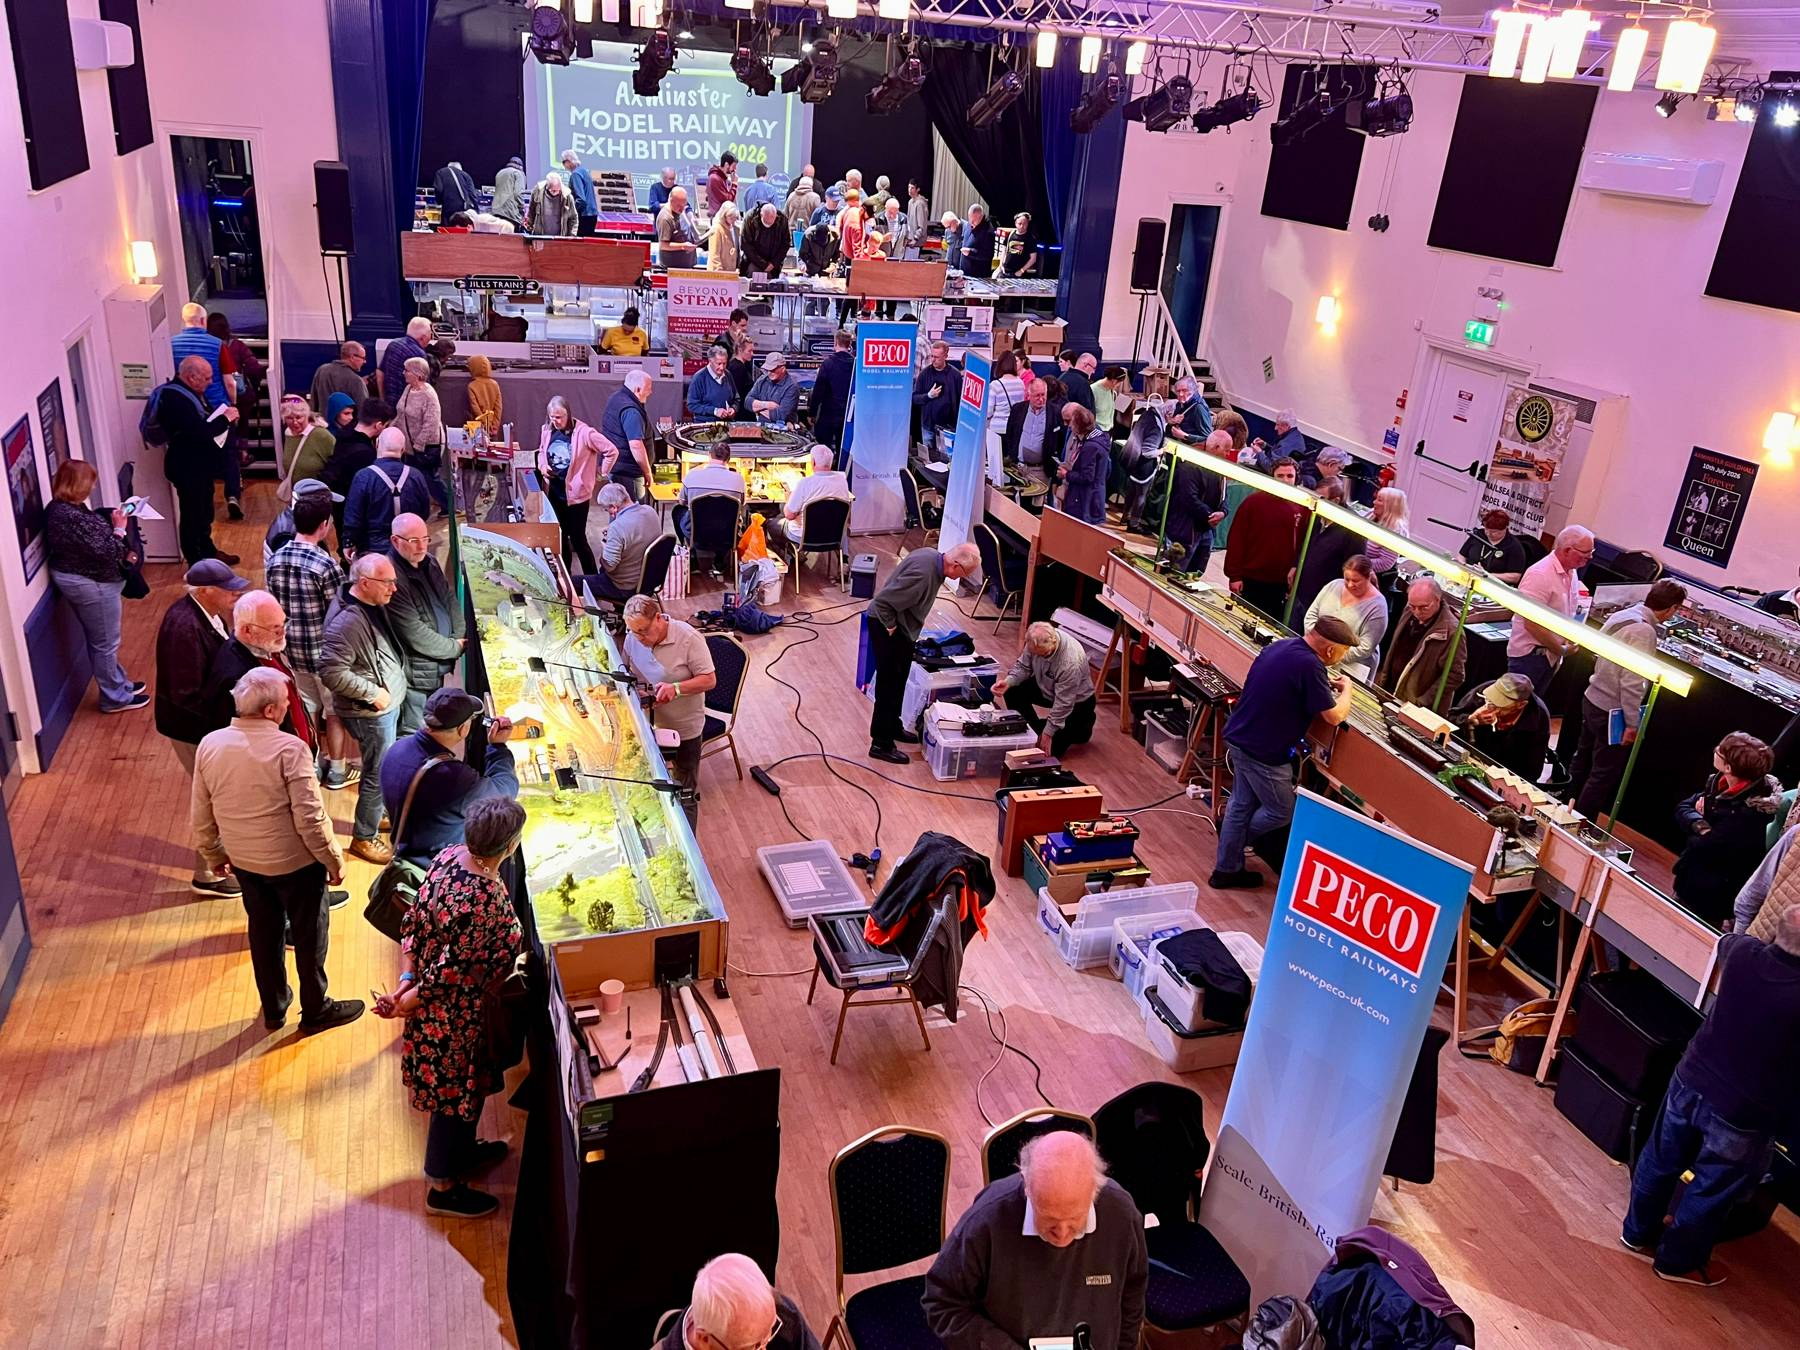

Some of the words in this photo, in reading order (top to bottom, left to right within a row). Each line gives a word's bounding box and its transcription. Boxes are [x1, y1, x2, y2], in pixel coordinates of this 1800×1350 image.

[615, 81, 732, 109] Axminster
[570, 106, 662, 133] MODEL
[669, 113, 779, 139] RAILWAY
[571, 133, 720, 160] EXHIBITION
[728, 142, 768, 164] 2026
[673, 293, 733, 307] STEAM
[679, 286, 728, 296] BEYOND
[867, 344, 906, 363] PECO
[963, 376, 982, 403] PECO
[1702, 462, 1715, 472] 10th
[1714, 466, 1727, 477] July
[1726, 469, 1742, 480] 2026
[1702, 472, 1736, 491] Forever
[1482, 493, 1500, 507] MODEL
[1501, 500, 1526, 517] RAILWAY
[1526, 511, 1545, 523] CLUB
[1516, 493, 1544, 509] DISTRICT
[1681, 536, 1715, 558] Queen
[1303, 860, 1419, 953] PECO
[1284, 914, 1334, 949] MODEL
[1340, 944, 1418, 995] RAILWAYS
[1288, 961, 1390, 1026] www.peco-uk.com
[1215, 1154, 1254, 1191] Scale.
[1258, 1183, 1310, 1231] British.
[1315, 1223, 1335, 1249] Ra
